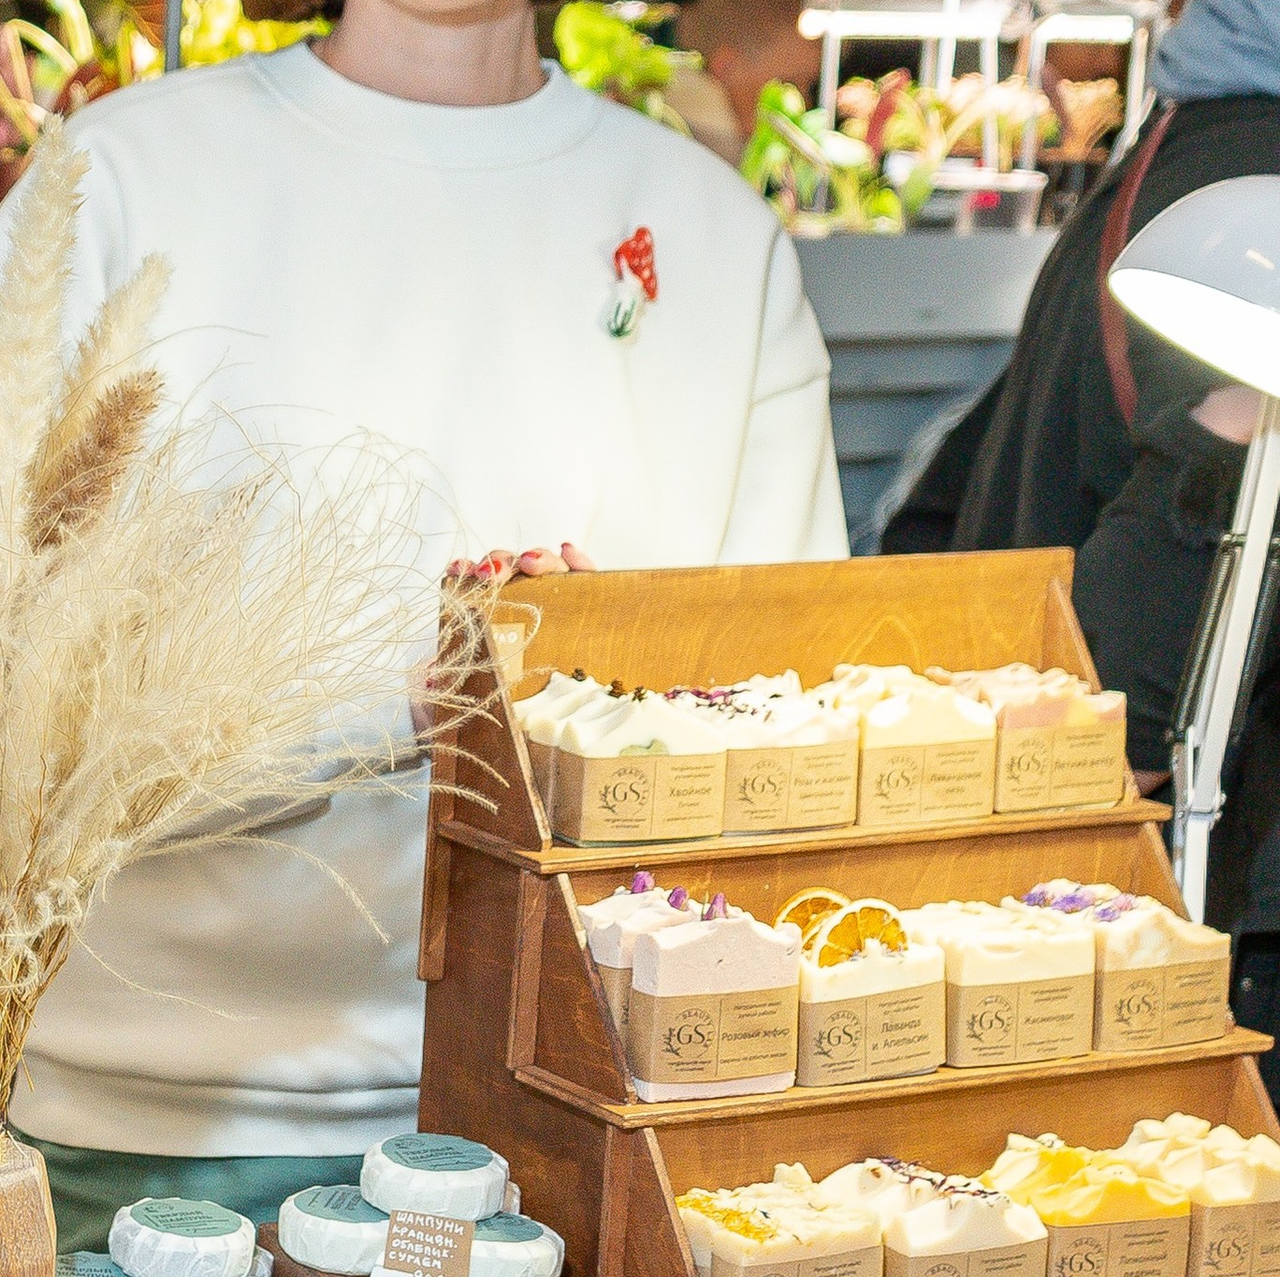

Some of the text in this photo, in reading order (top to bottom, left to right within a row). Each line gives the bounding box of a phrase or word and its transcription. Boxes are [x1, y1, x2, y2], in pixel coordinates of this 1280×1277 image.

[1019, 753, 1042, 772] GS
[751, 775, 777, 795] GS
[886, 770, 910, 789] GS
[612, 782, 641, 802] GS
[1127, 993, 1153, 1015] GS
[979, 1011, 1005, 1031] GS
[677, 1023, 706, 1046] GS
[828, 1025, 853, 1046] GS
[396, 1211, 466, 1235] ШАМПУНИ
[1217, 1239, 1242, 1259] GS
[1070, 1253, 1095, 1273] GS
